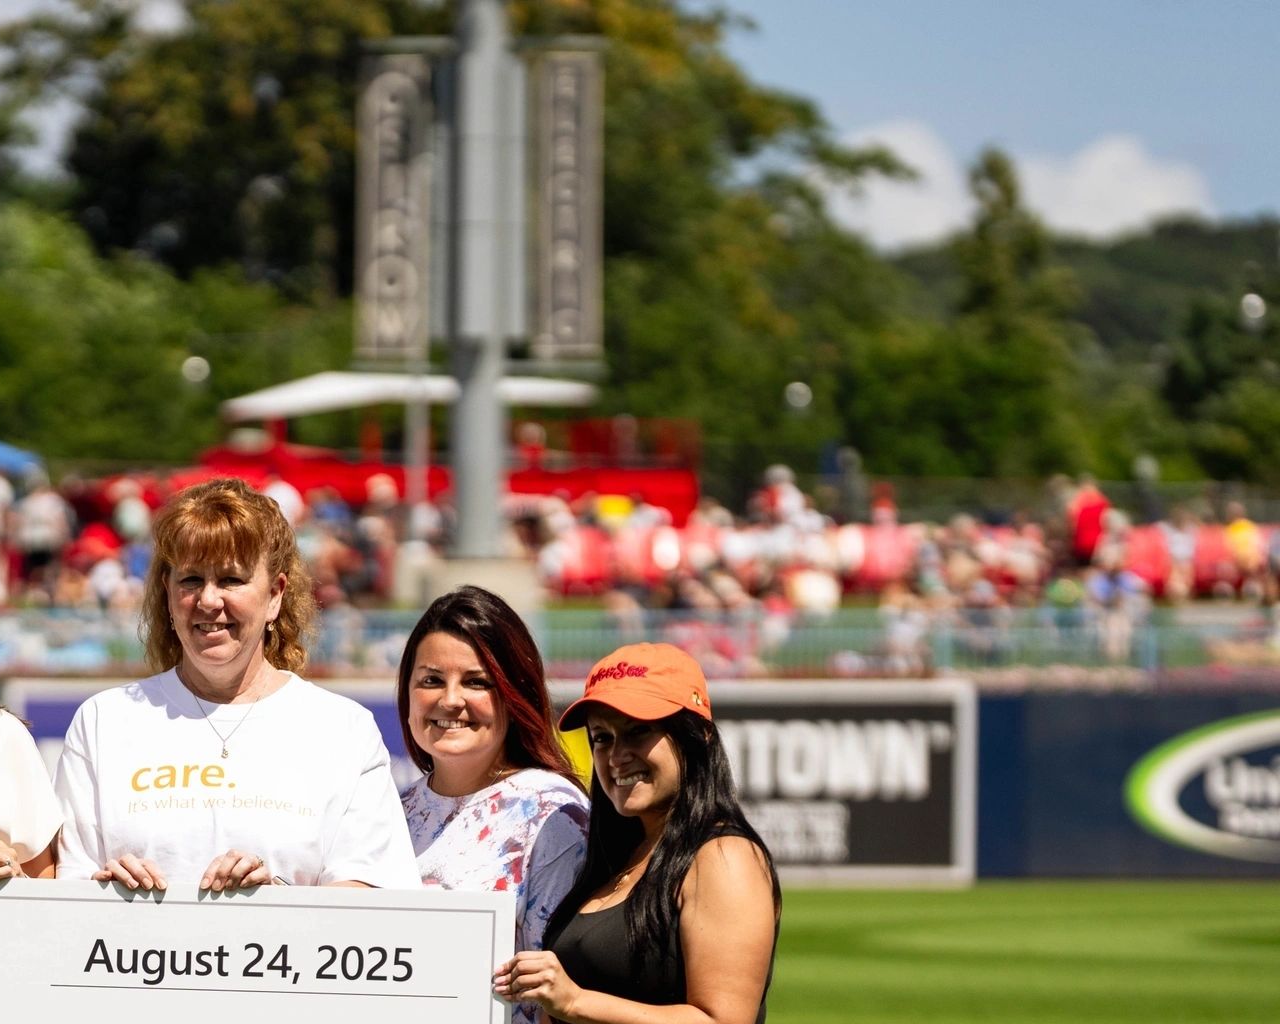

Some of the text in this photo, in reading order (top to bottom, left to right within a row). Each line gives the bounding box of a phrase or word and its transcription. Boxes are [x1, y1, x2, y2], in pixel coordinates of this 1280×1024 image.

[130, 764, 237, 792] care.
[155, 796, 195, 809] what
[203, 799, 226, 809] we
[232, 795, 292, 811] believe
[84, 939, 412, 985] August 24, 2025
